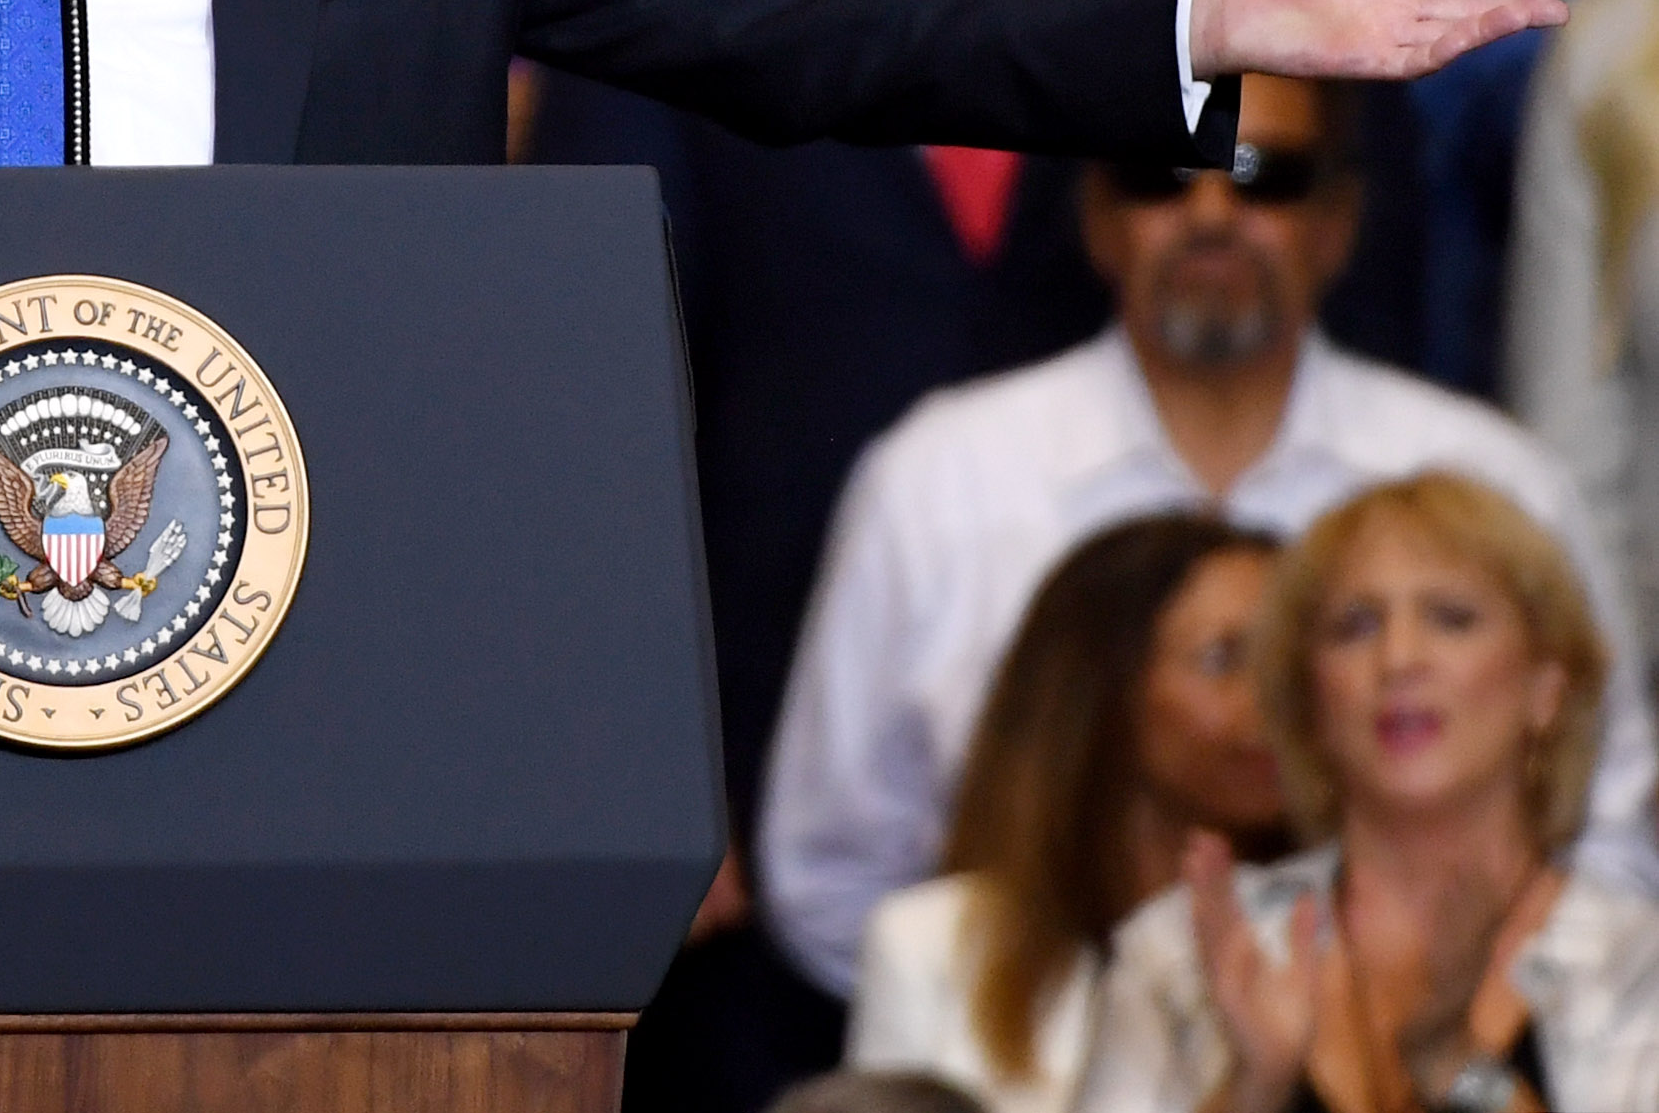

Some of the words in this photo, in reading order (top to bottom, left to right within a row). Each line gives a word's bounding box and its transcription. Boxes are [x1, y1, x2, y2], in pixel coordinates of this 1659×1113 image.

[73, 299, 116, 326] OF
[127, 307, 183, 352] THE
[196, 346, 291, 535] UNITED
[116, 580, 272, 722] STATES
